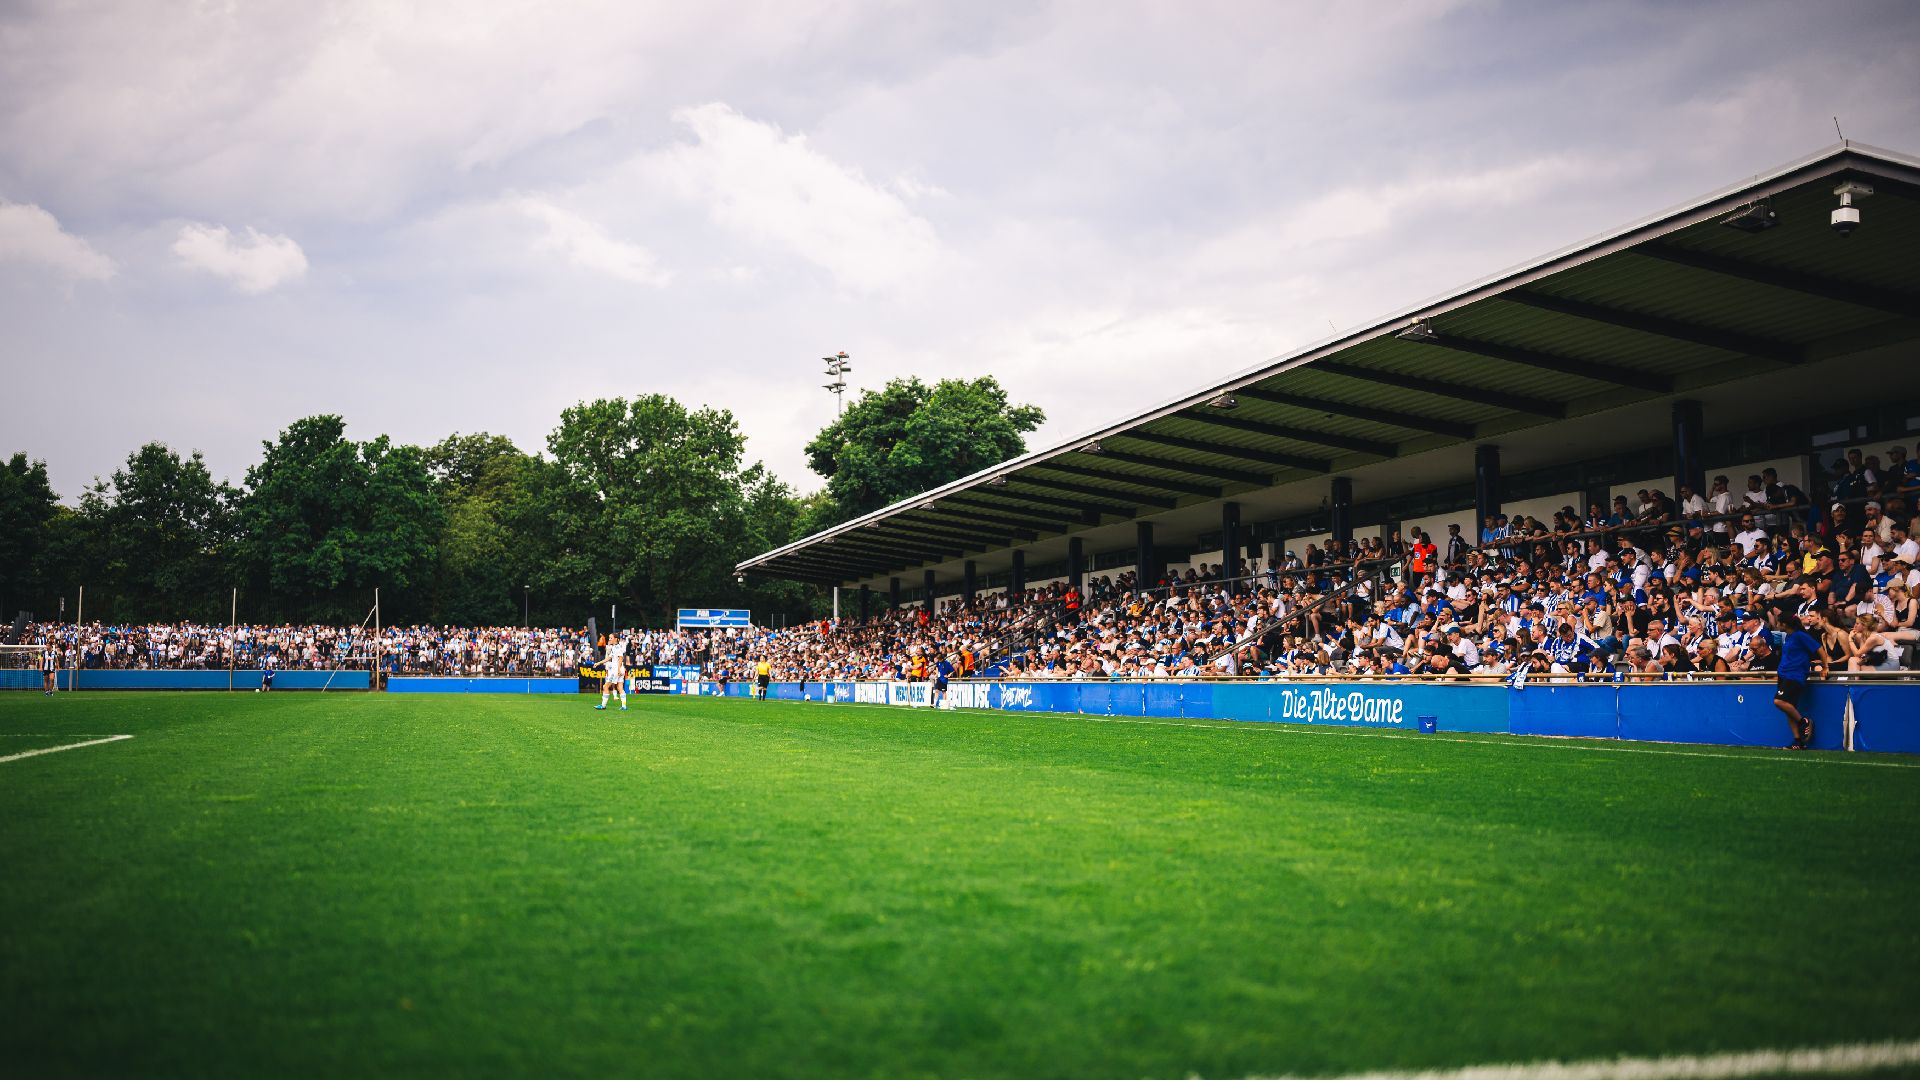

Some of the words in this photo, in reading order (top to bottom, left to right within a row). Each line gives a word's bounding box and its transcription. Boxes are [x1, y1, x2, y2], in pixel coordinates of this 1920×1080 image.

[946, 683, 974, 708] ERTHA
[1281, 688, 1307, 719] Die
[1307, 687, 1347, 722] Alte
[1347, 691, 1403, 724] Dame
